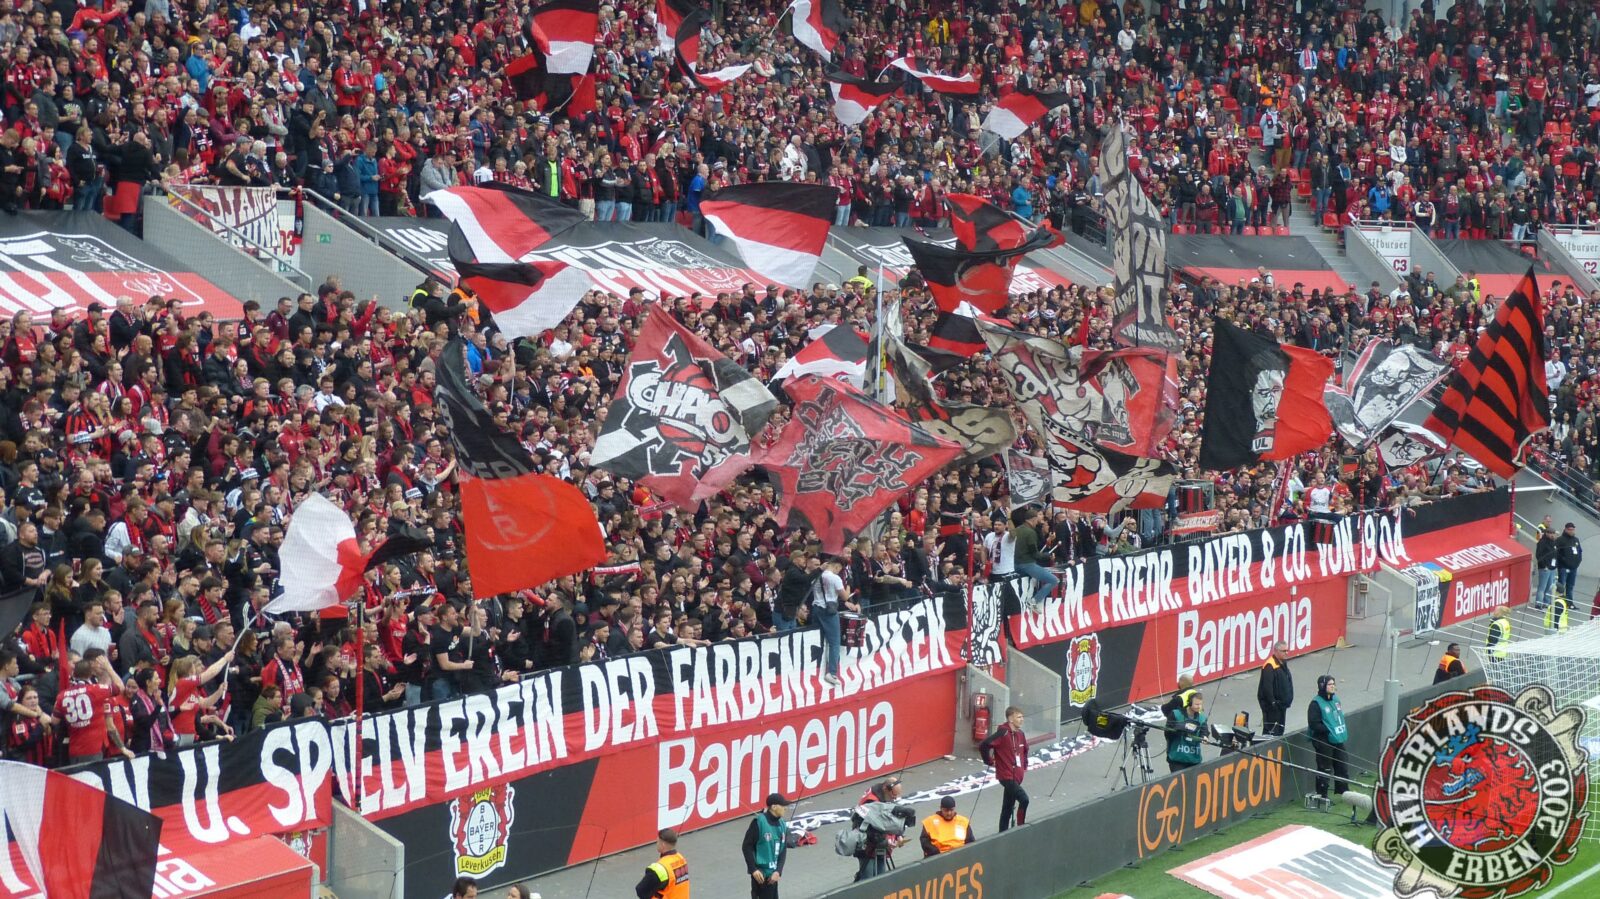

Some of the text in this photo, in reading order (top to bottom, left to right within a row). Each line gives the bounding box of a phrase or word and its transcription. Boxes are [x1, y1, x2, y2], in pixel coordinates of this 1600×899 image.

[1393, 258, 1408, 272] C3
[1455, 571, 1509, 617] Barmenia
[579, 656, 660, 751] DER
[1098, 549, 1183, 623] FRIEDR.
[1188, 533, 1253, 606] BAYER
[1259, 530, 1275, 589] &
[1282, 523, 1311, 581] CO.
[1177, 586, 1312, 684] Barmenia
[62, 693, 93, 723] 30
[657, 701, 894, 831] Barmenia
[1176, 743, 1201, 754] HOST
[1194, 745, 1282, 829] DITCON
[469, 821, 495, 836] BAYER
[461, 850, 502, 871] Leverkusen
